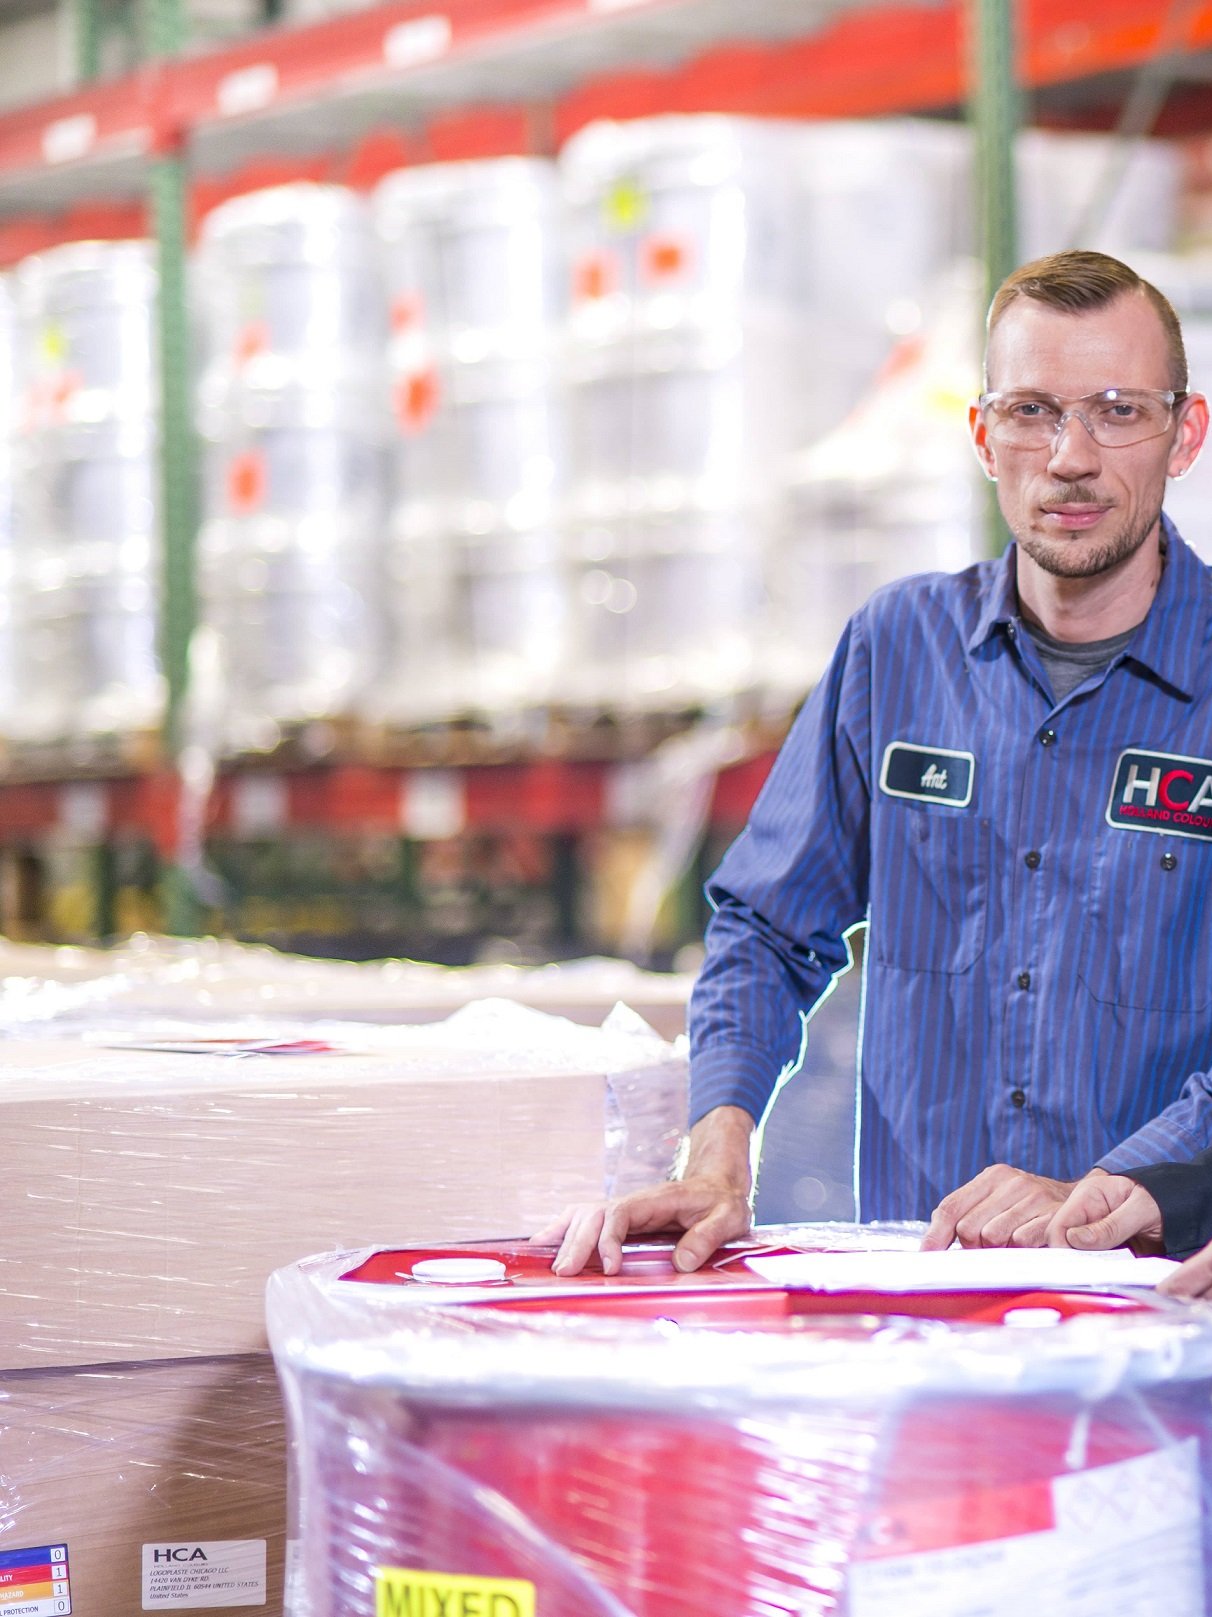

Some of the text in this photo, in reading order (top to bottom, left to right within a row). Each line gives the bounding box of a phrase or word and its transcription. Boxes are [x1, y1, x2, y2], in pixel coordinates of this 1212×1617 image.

[1120, 805, 1171, 821] HOLLAND
[55, 1550, 61, 1560] 0
[154, 1548, 208, 1562] HCA
[56, 1568, 62, 1577] 1
[190, 1567, 217, 1575] CHICAGO
[58, 1584, 63, 1594] 1
[384, 1582, 521, 1617] MIXED
[4, 1606, 39, 1616] PROTECTION
[58, 1601, 65, 1611] 0
